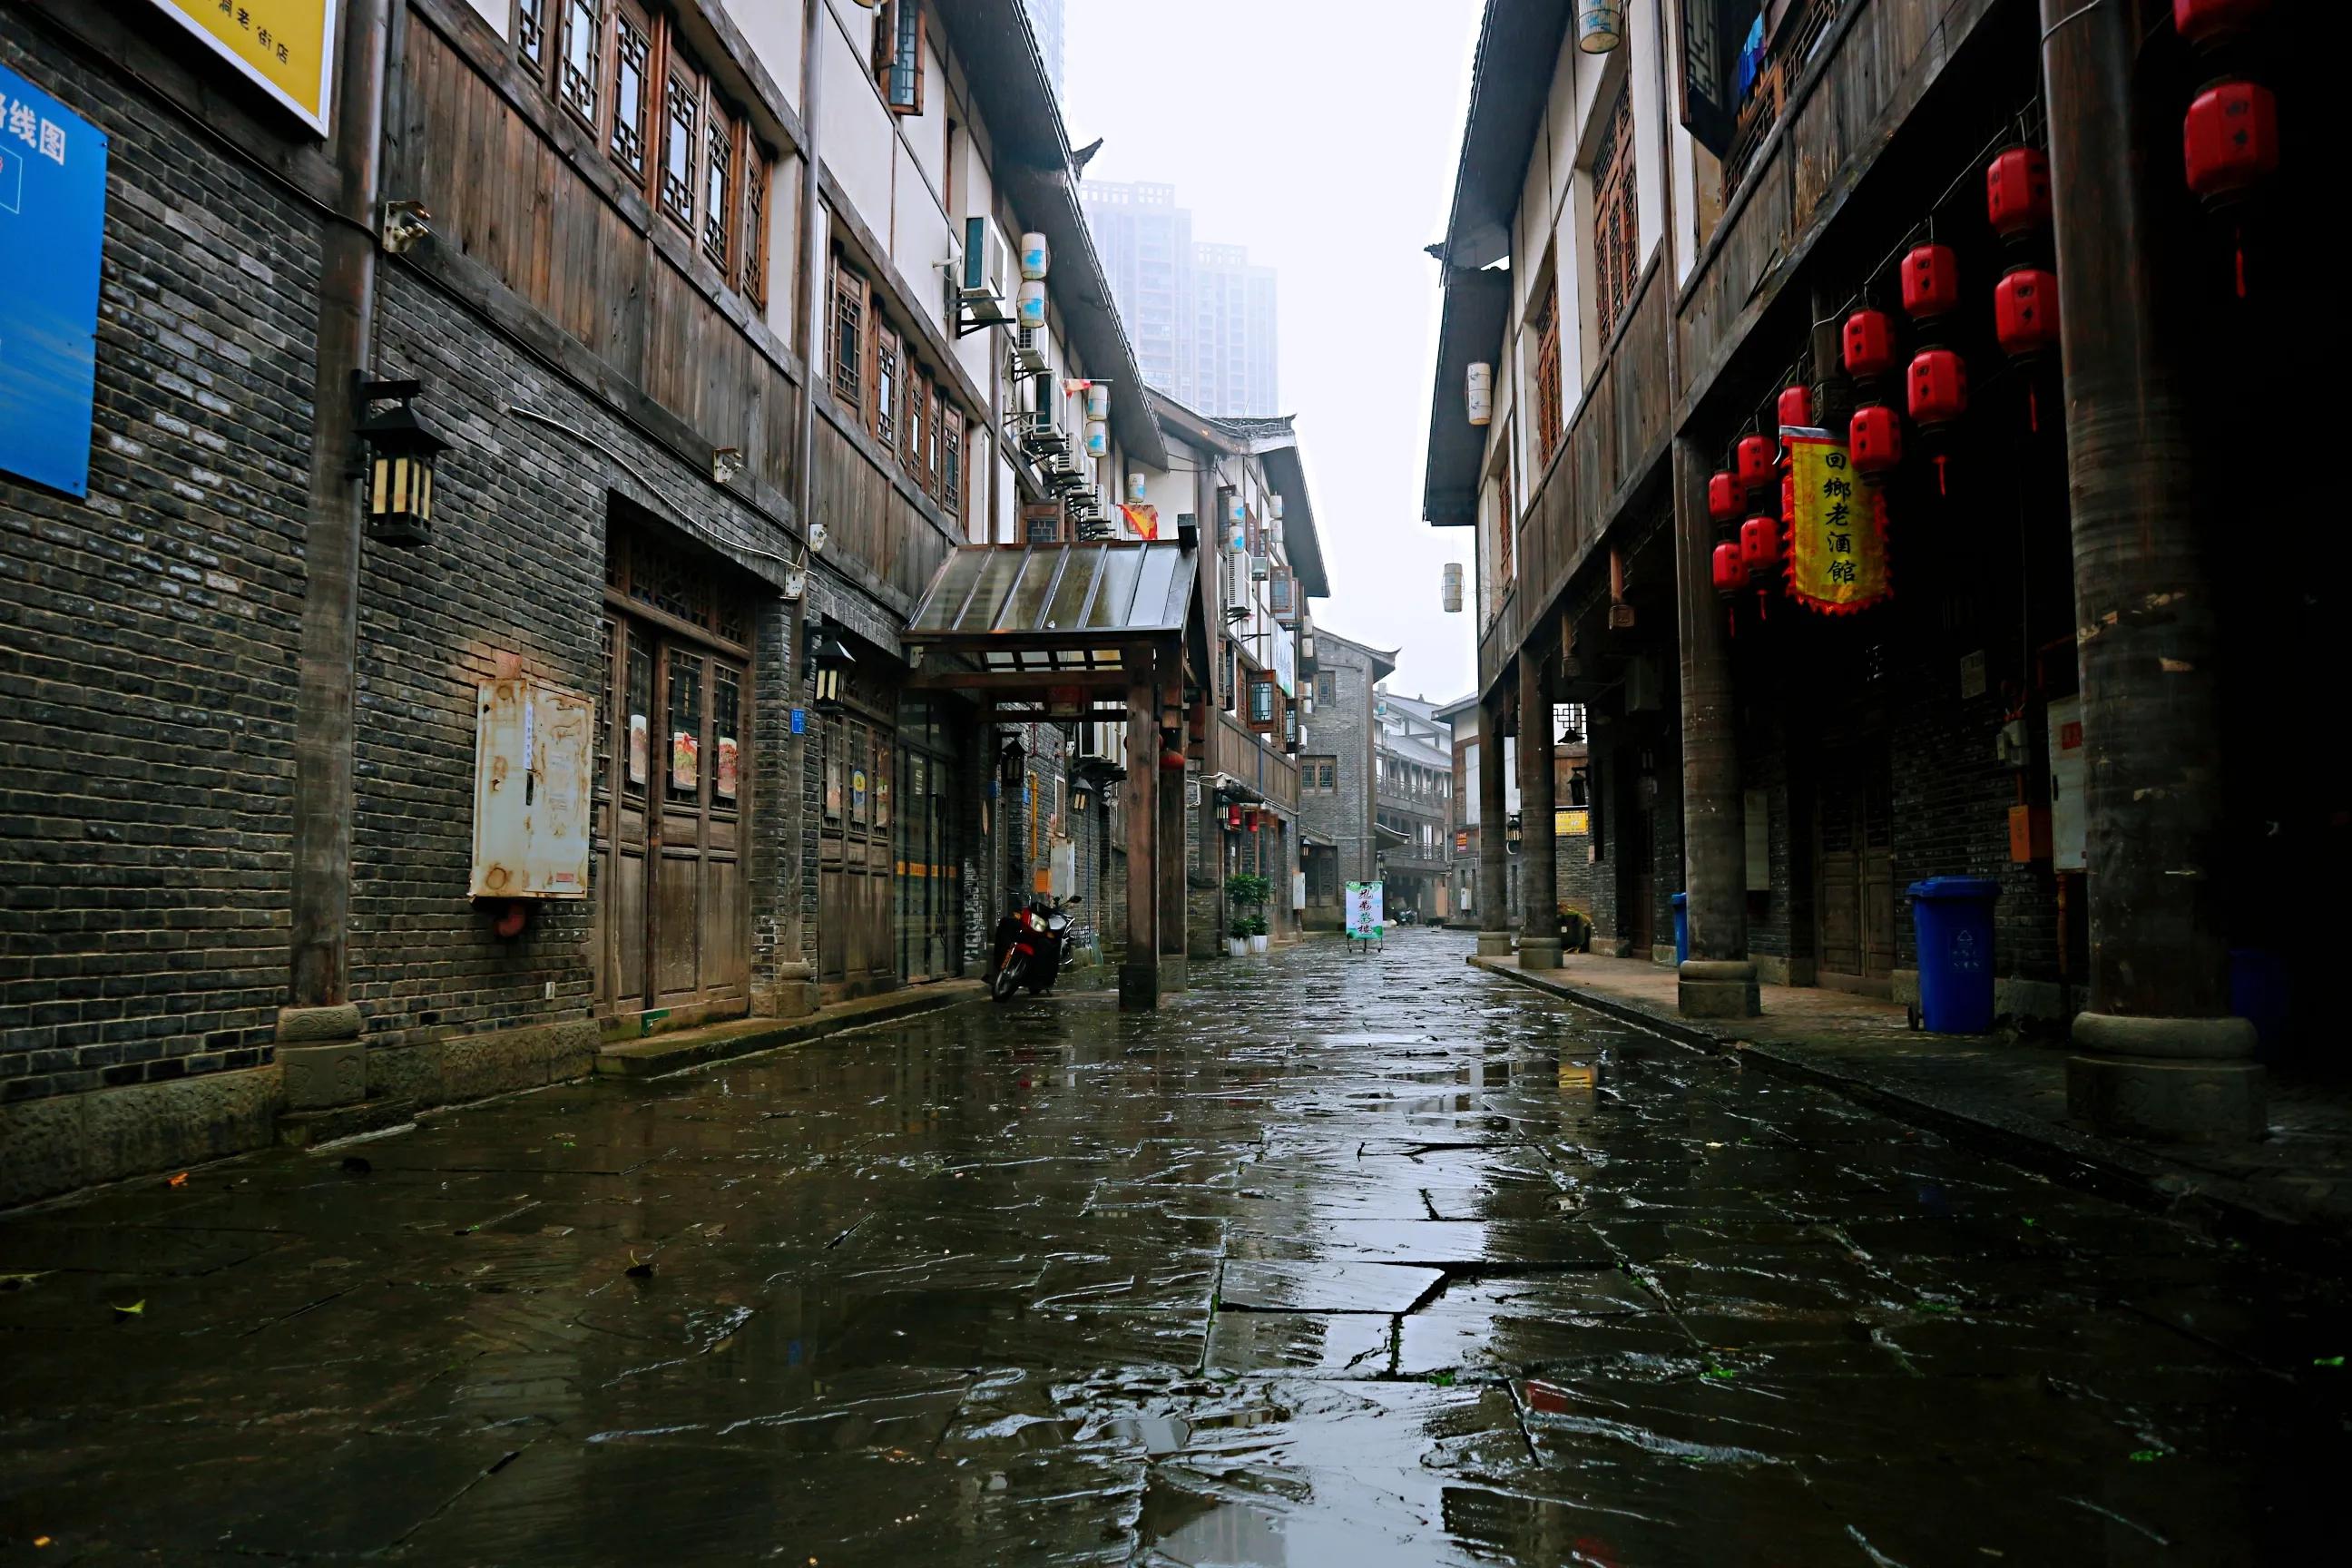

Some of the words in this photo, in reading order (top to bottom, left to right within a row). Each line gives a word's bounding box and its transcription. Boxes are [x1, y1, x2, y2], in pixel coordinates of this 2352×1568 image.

[207, 0, 289, 65] 洞老街店
[0, 93, 66, 165] 线图
[1823, 452, 1857, 584] 回鄉老酒館
